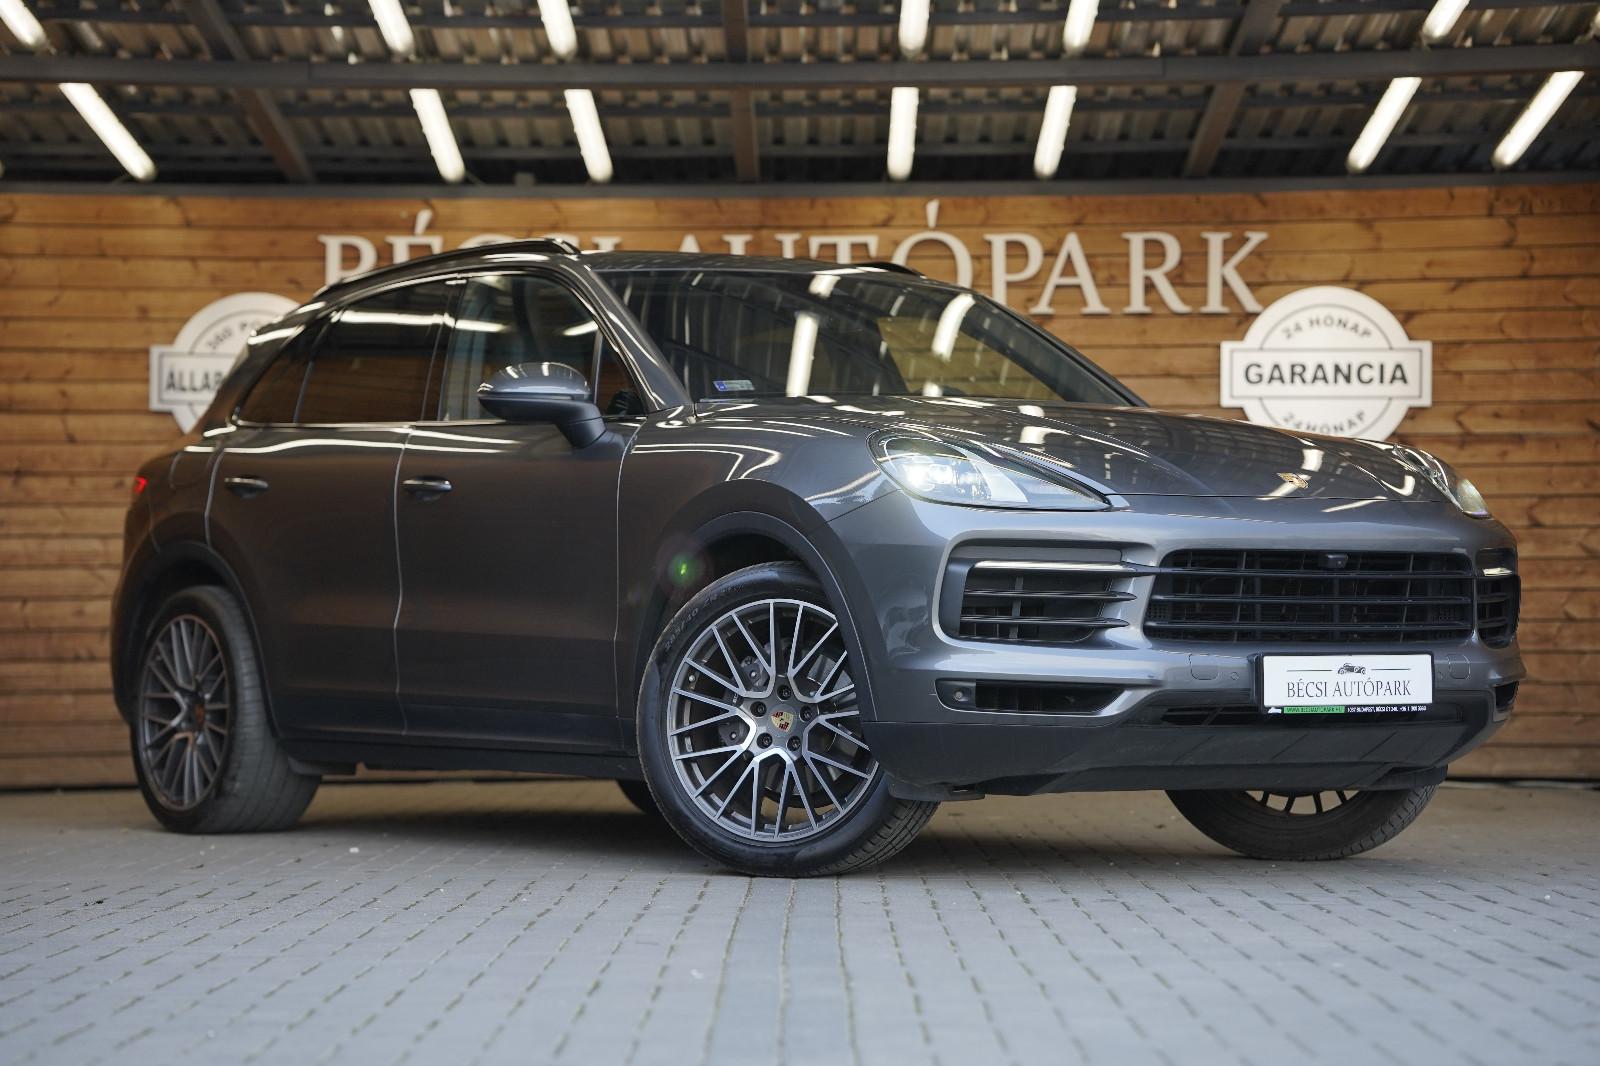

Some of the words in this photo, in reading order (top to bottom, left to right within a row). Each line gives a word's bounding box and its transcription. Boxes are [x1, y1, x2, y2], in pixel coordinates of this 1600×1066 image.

[679, 199, 1268, 314] ÓPARK
[1244, 363, 1408, 384] GARANCIA
[1287, 678, 1328, 698] BÉCSI
[1332, 677, 1412, 697] AUTÓPARK
